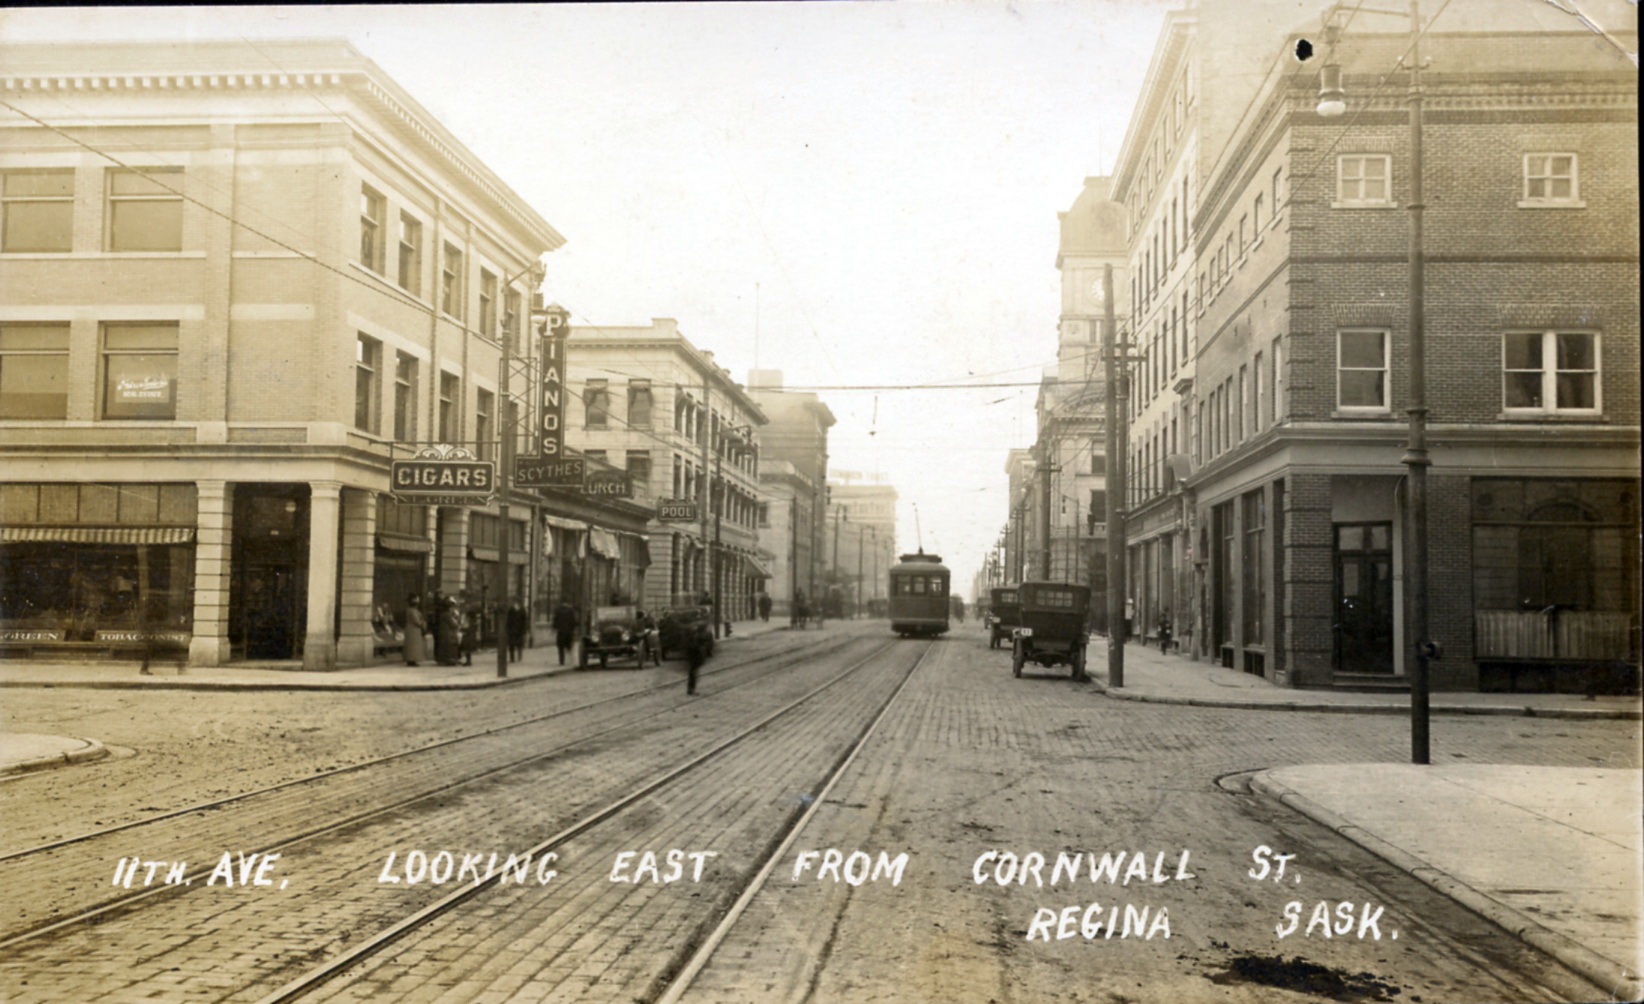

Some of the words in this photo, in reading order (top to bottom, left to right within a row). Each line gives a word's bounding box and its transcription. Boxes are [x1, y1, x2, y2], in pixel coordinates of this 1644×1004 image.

[543, 314, 563, 455] PIANOS
[397, 467, 487, 487] CIGARS
[517, 460, 582, 482] SCYTHES
[661, 506, 692, 519] POOL
[100, 633, 187, 642] TOBACCONIST
